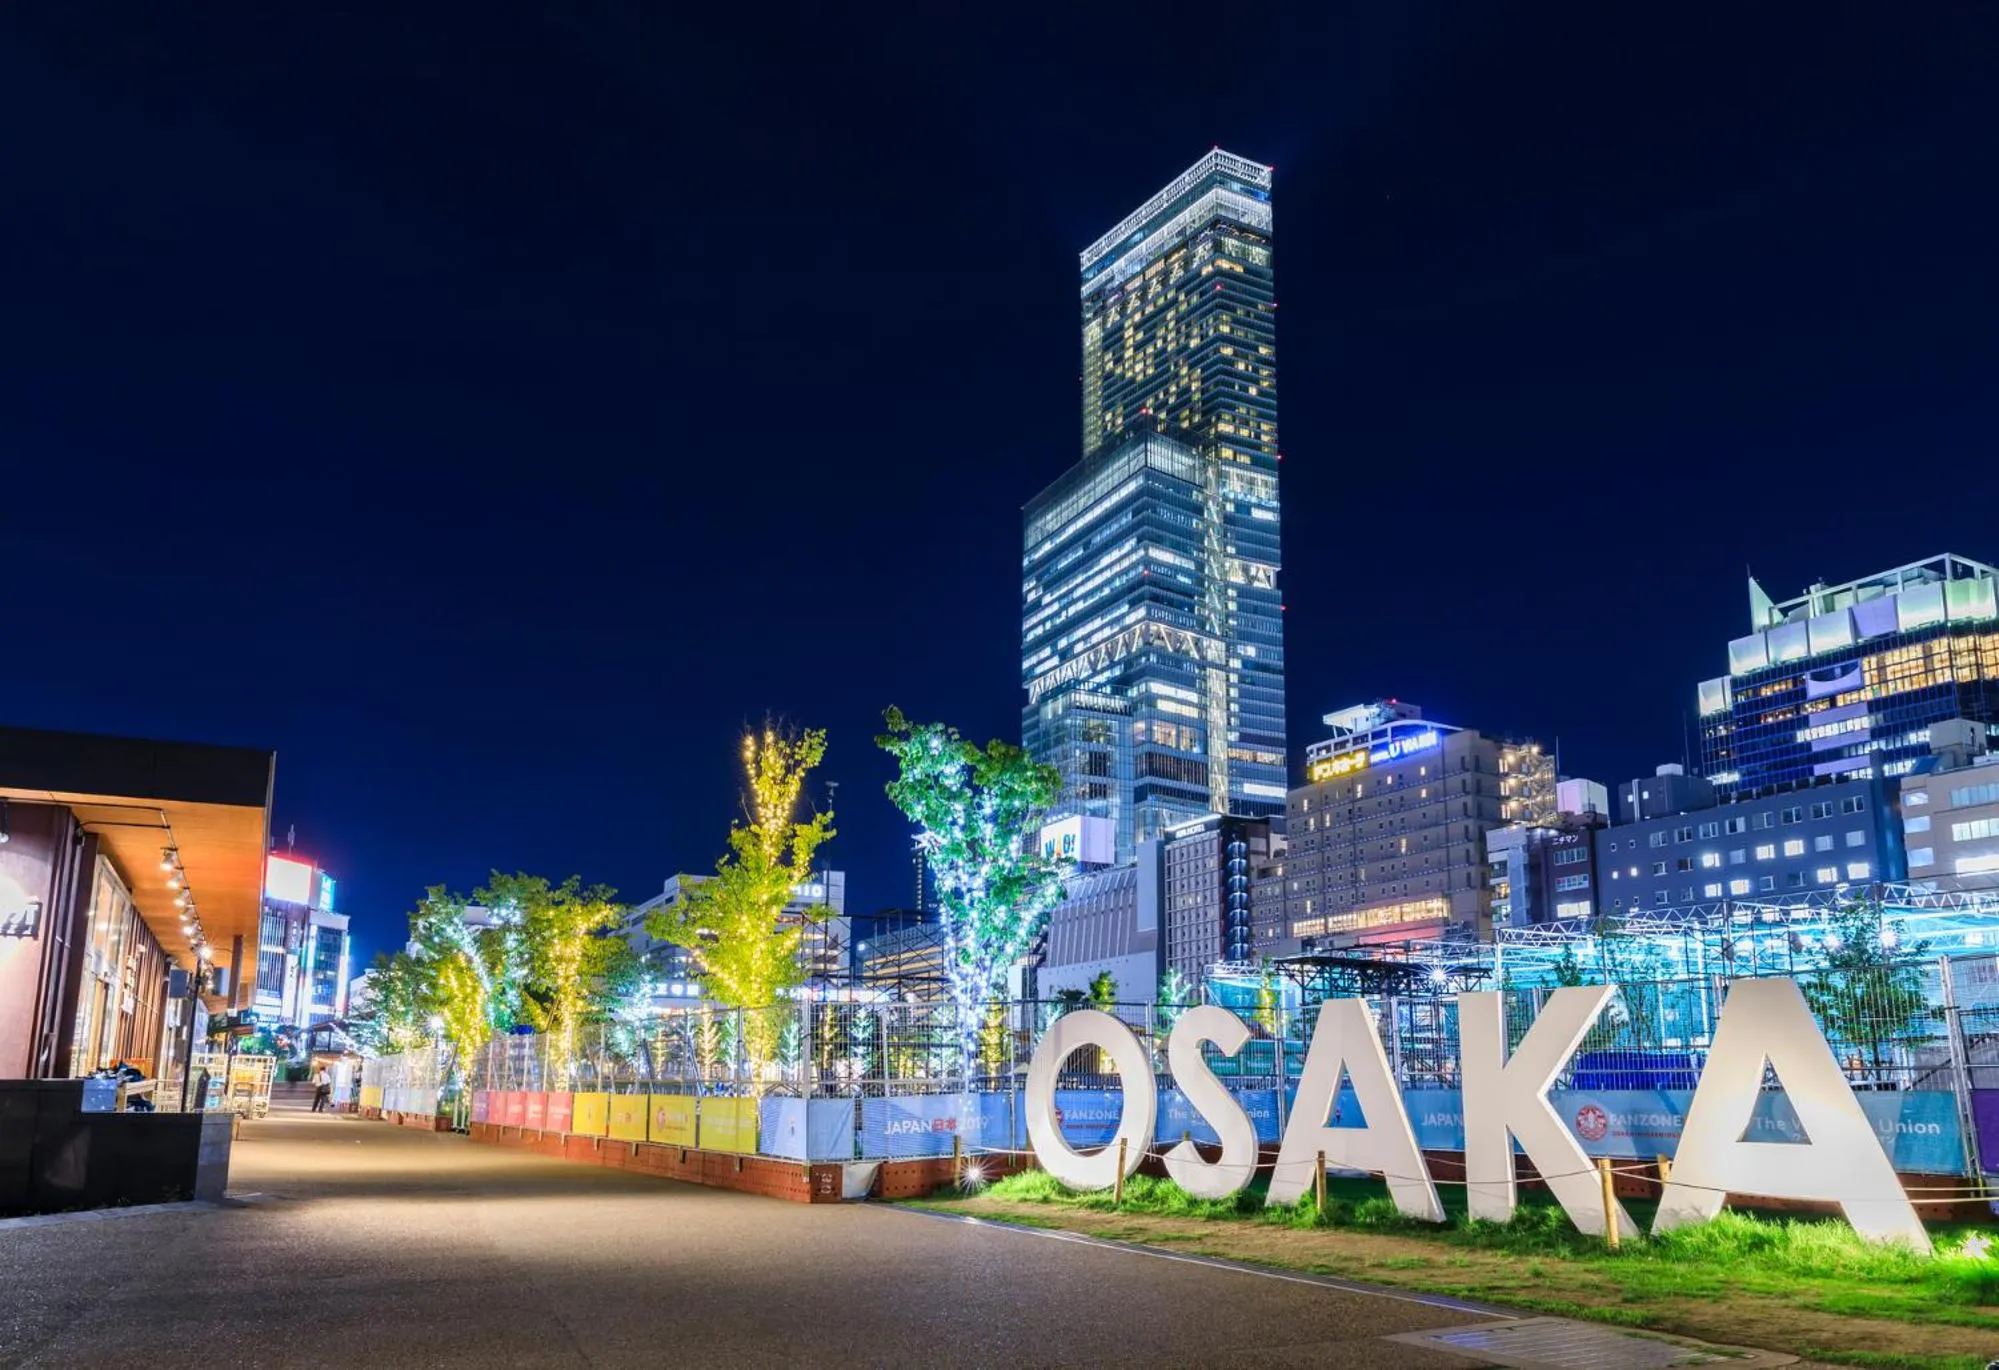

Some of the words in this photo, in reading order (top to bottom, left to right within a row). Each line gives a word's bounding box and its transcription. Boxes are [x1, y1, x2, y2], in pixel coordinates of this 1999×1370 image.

[1025, 976, 1934, 1258] OSAKA
[1064, 1109, 1119, 1120] FANZONE
[1168, 1107, 1188, 1119] The
[1247, 1106, 1270, 1119] nion
[1609, 1113, 1683, 1127] FANZONE
[1756, 1116, 1785, 1131] The
[1879, 1117, 1940, 1135] Union
